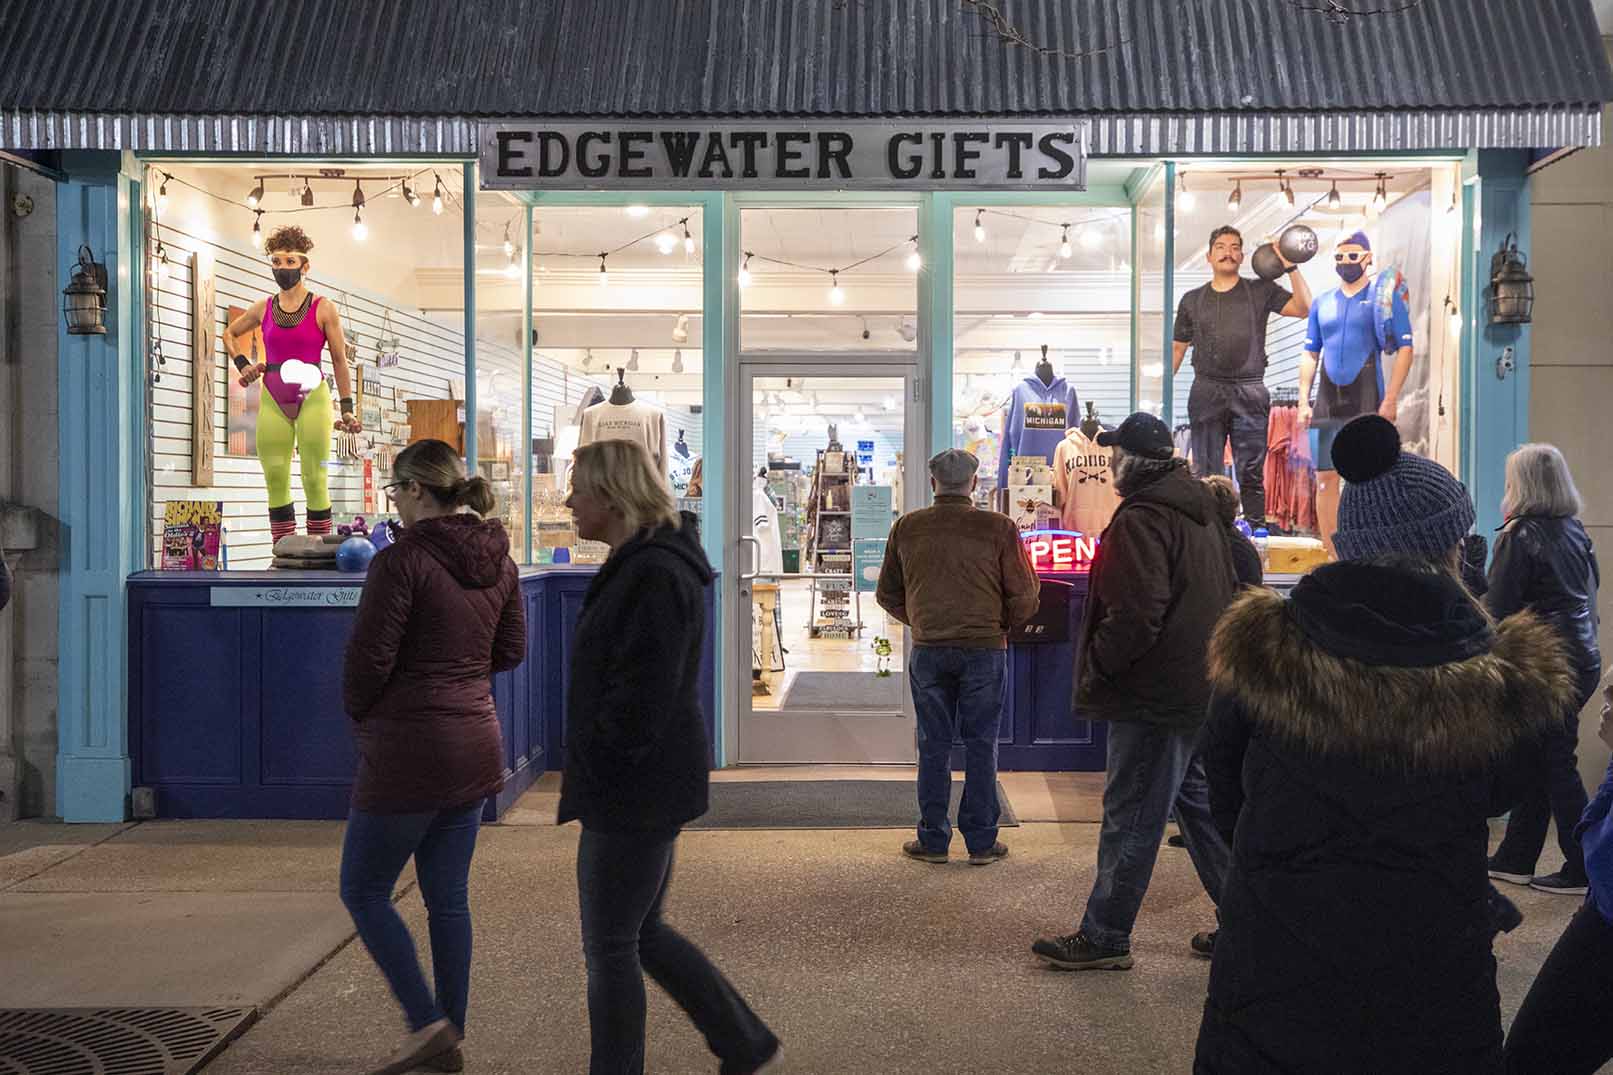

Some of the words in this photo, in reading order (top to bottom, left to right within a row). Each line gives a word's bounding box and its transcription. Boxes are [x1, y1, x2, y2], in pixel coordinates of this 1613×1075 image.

[496, 131, 854, 178] EDGEWATER
[888, 132, 1075, 179] GIFTS
[1026, 416, 1065, 425] MICHIGAN
[674, 482, 689, 490] MIC
[1030, 536, 1095, 564] PEN
